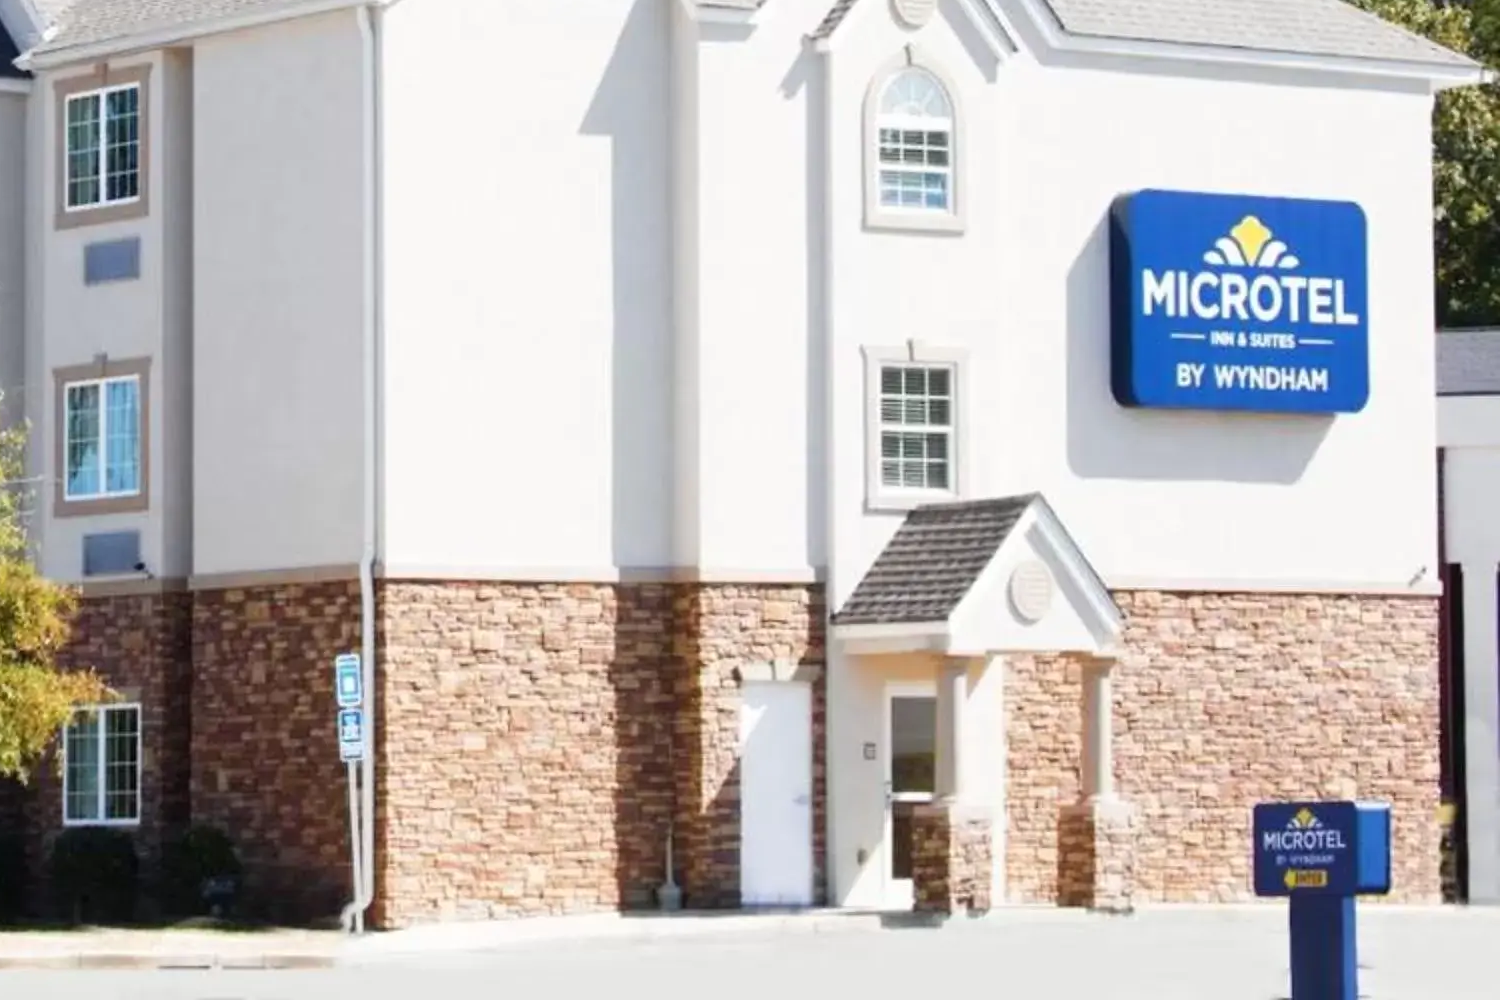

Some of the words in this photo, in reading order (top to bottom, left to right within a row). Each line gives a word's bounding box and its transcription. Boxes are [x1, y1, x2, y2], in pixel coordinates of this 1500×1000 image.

[1142, 268, 1359, 325] MICROTEL
[1210, 330, 1235, 346] INN
[1237, 331, 1248, 347] &
[1249, 331, 1296, 349] SUITES
[1176, 362, 1205, 387] BY
[1213, 363, 1329, 392] WYNDHAM
[1263, 830, 1346, 851] MICROTEL
